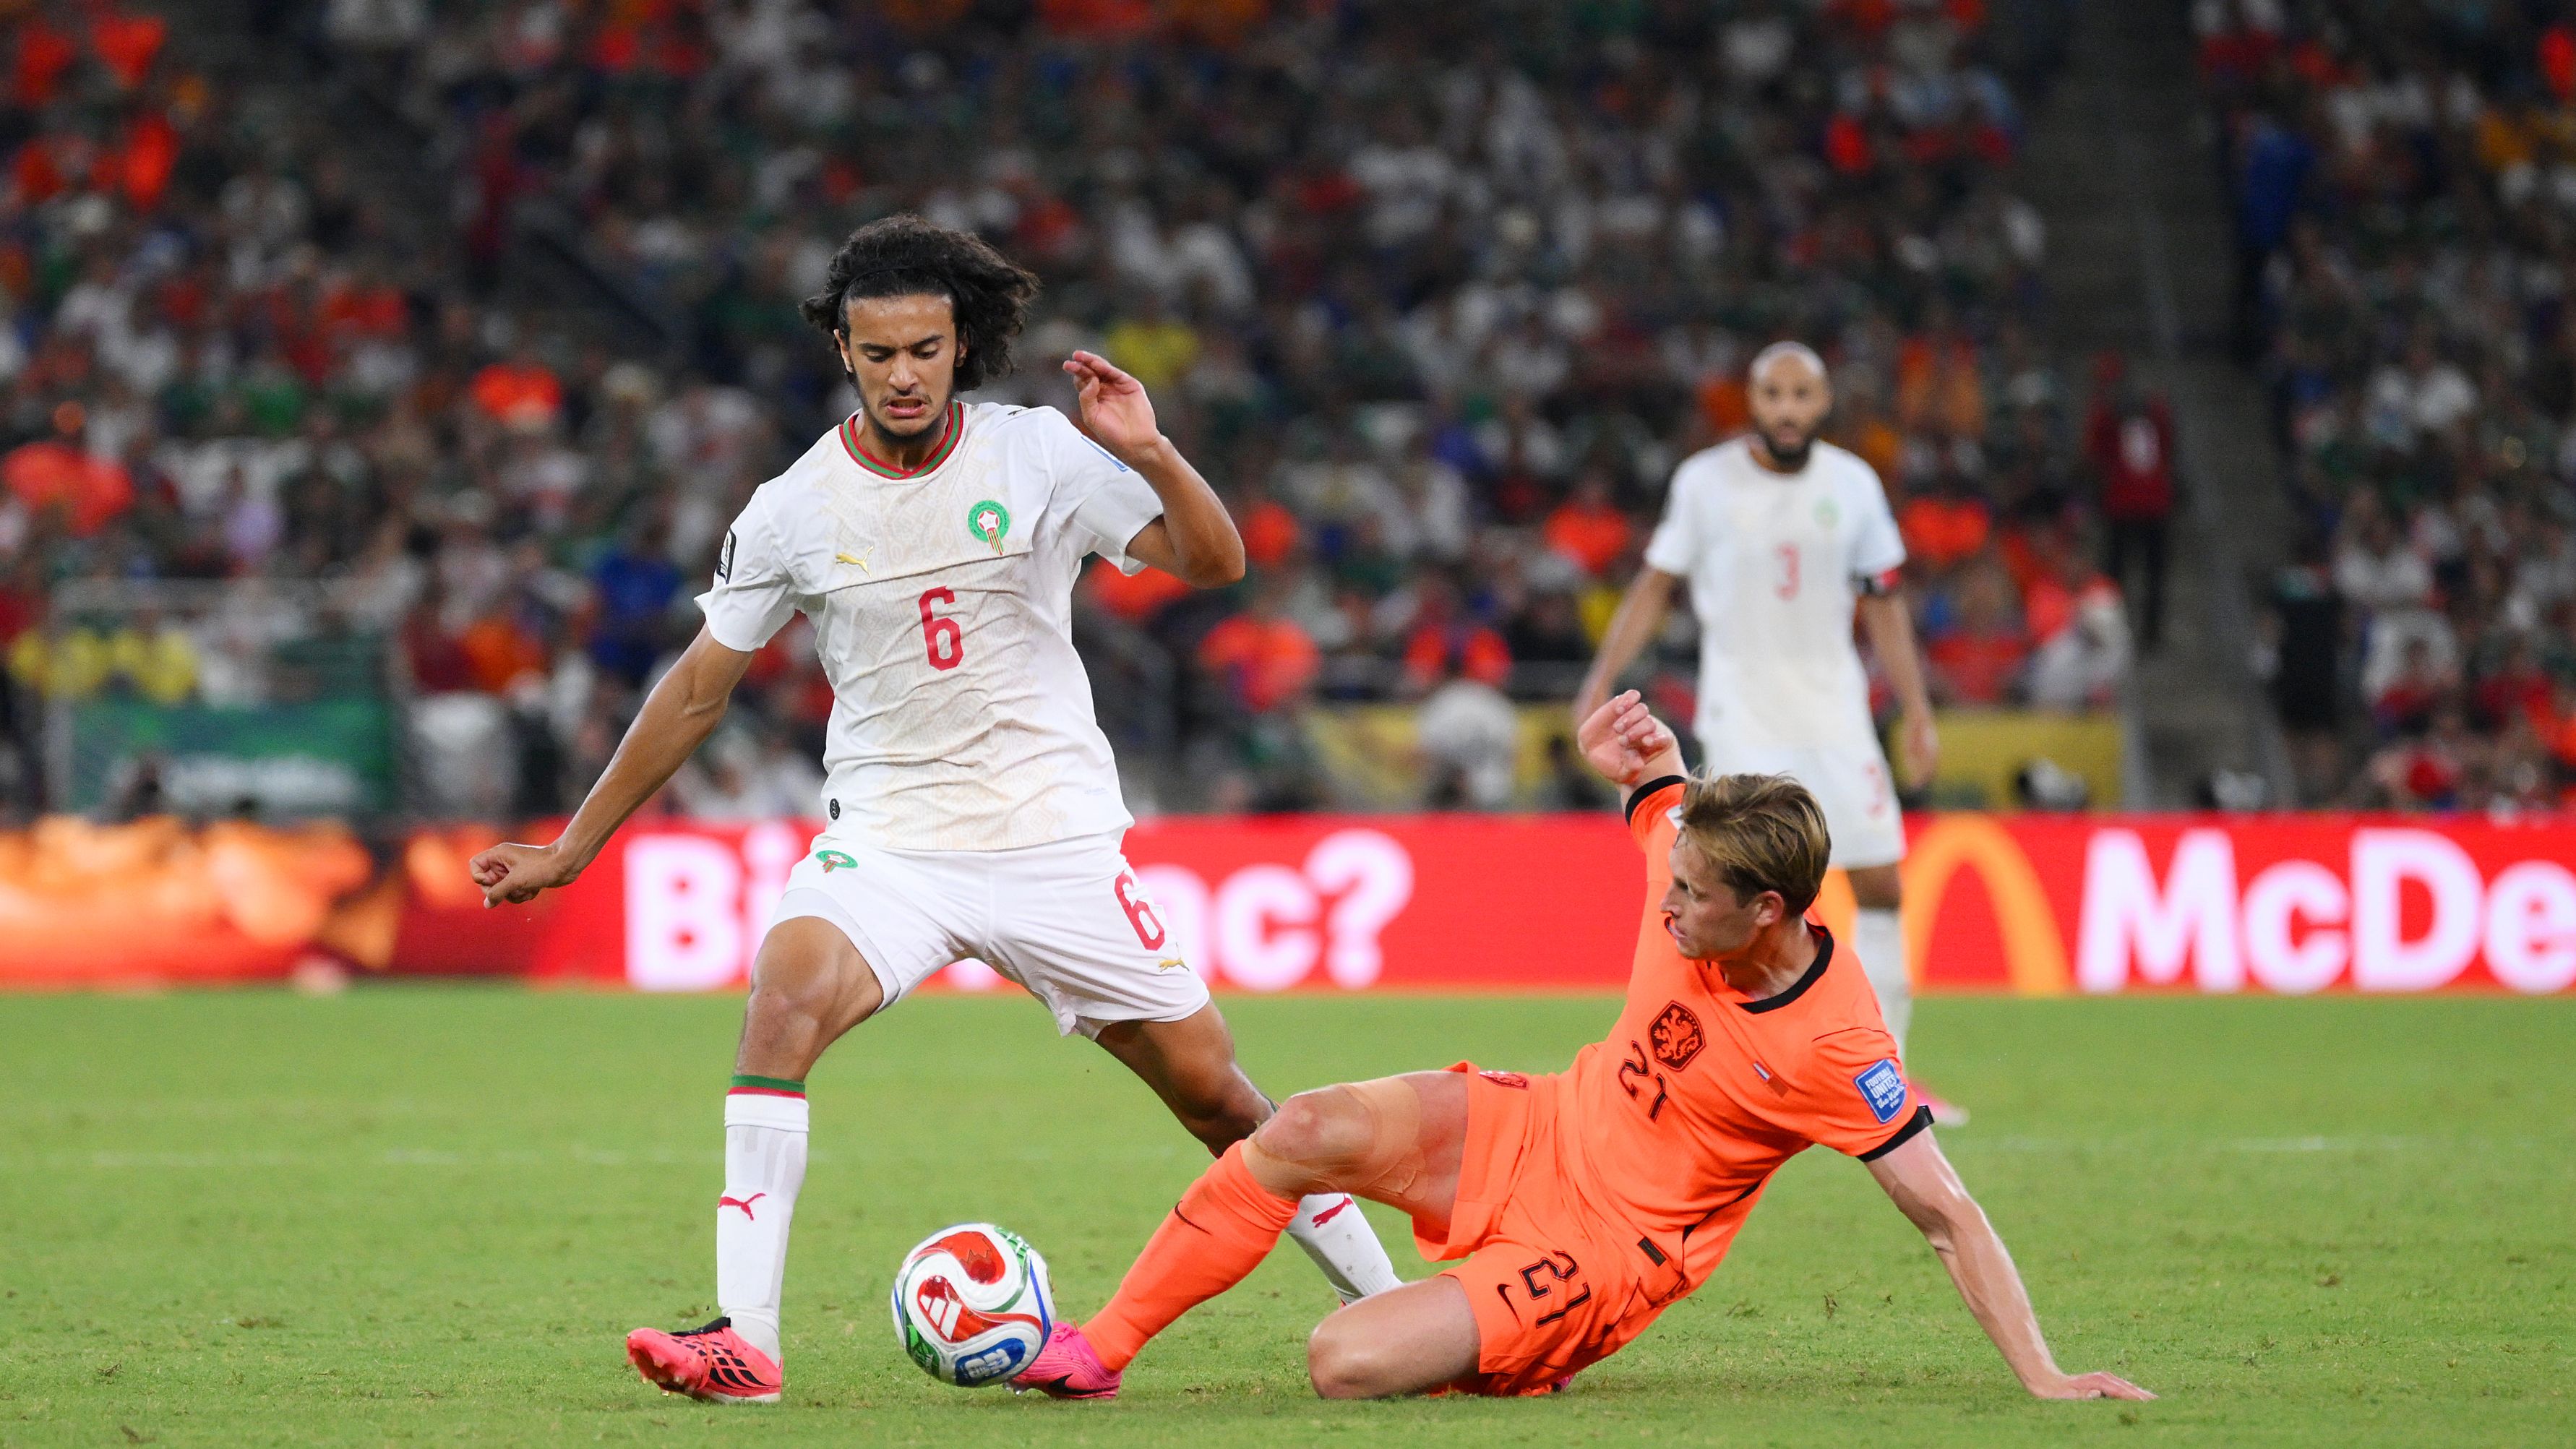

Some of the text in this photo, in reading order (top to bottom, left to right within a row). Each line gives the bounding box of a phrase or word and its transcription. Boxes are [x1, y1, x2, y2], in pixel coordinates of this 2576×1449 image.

[1773, 541, 1801, 601] 3
[918, 585, 963, 671] 6
[624, 824, 798, 991] Bi
[1114, 870, 1165, 952] 6
[2073, 827, 2576, 994] McDe
[1618, 1039, 1667, 1124] 21
[1865, 1066, 1892, 1090] FOOTBALL
[1870, 1074, 1897, 1098] UNITES
[1518, 1250, 1591, 1328] 21
